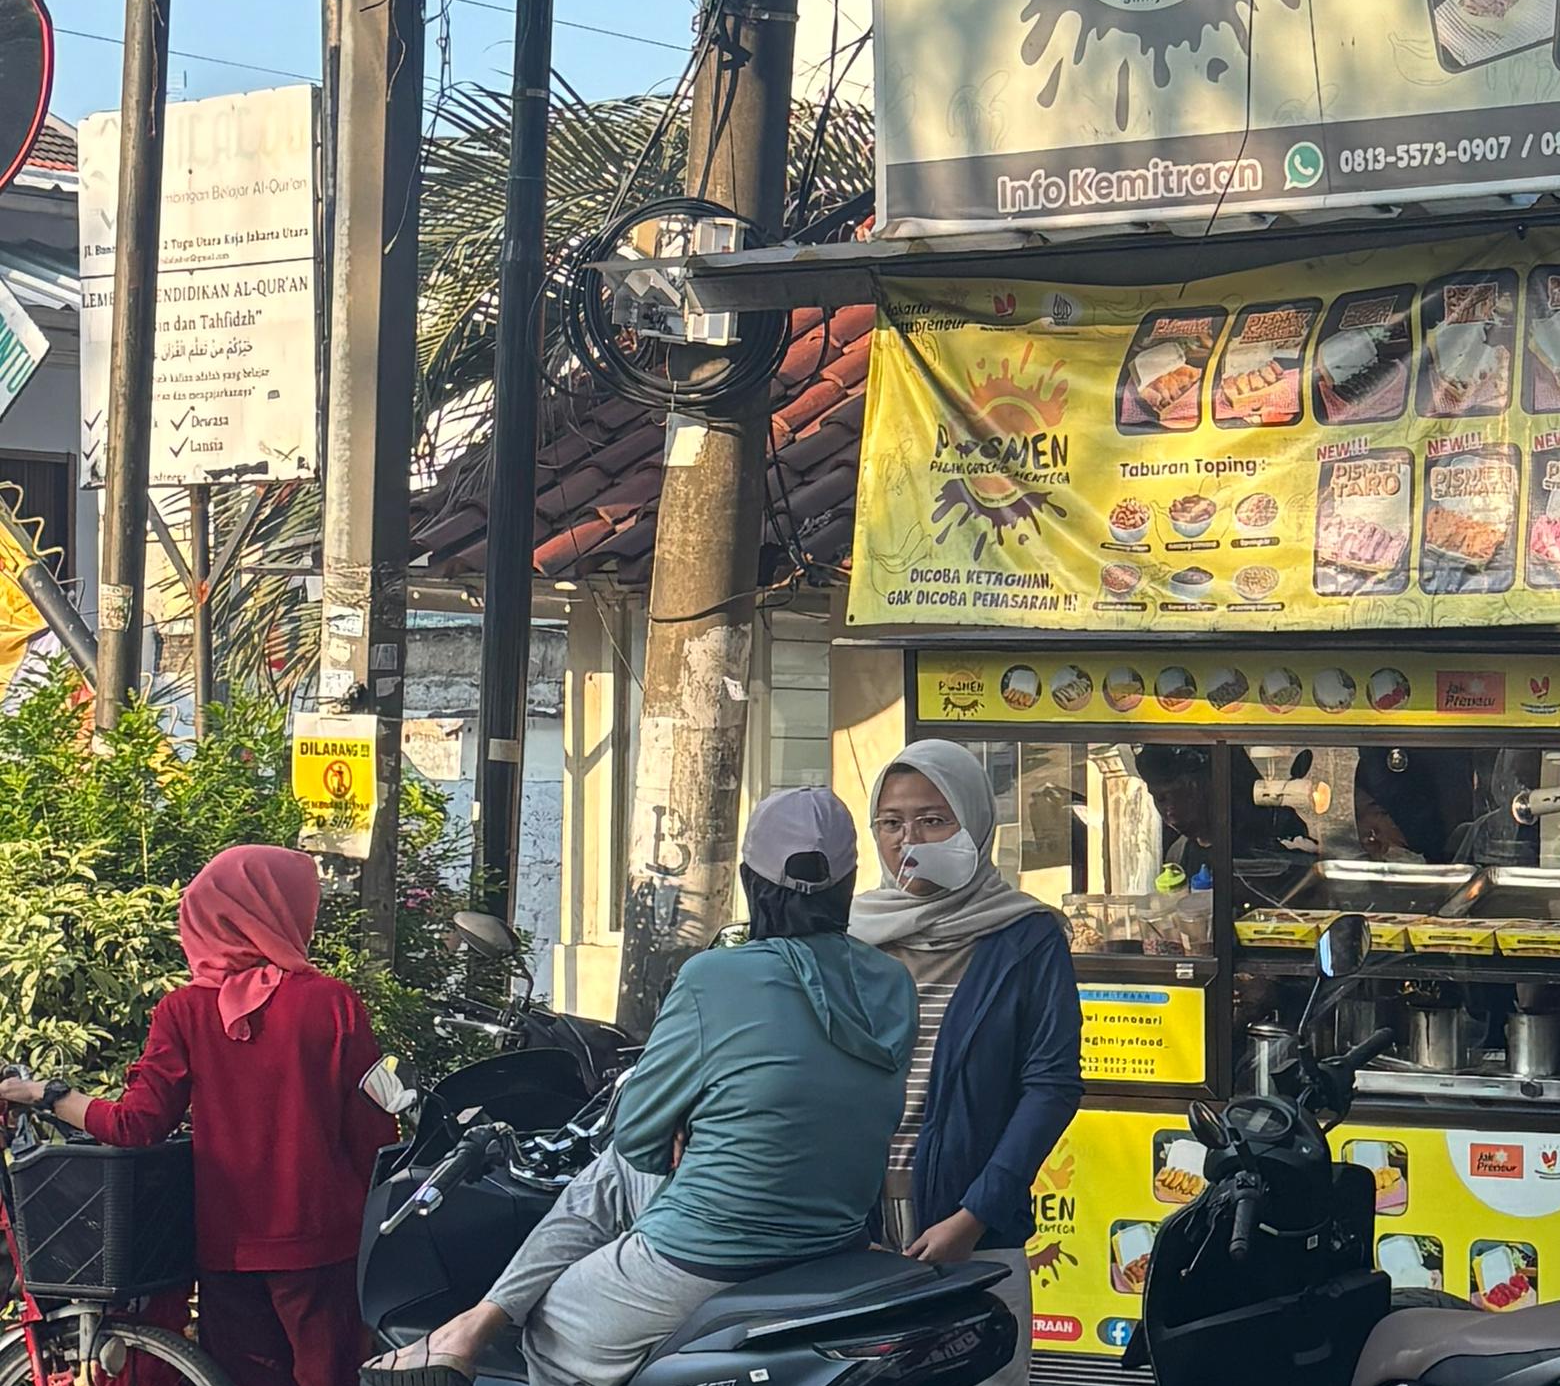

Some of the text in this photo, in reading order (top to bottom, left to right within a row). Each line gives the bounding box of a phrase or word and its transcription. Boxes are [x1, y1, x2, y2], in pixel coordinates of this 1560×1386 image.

[998, 169, 1066, 213] Info
[1069, 158, 1263, 207] Kemitraan
[1339, 135, 1512, 174] 0813-5573-0907
[1519, 132, 1535, 159] /
[196, 235, 222, 248] Utara
[245, 228, 280, 245] Jakarta
[282, 226, 309, 240] Utara
[155, 282, 230, 304] ENDIDIKAN
[233, 275, 309, 298] AL-QUR'AN
[173, 316, 197, 332] dan
[1316, 437, 1369, 461] NEW!!!
[1427, 432, 1482, 456] NEW!!!
[1120, 457, 1258, 479] Taburan Toping
[1332, 472, 1401, 497] TARO
[909, 567, 961, 585] DICOBA
[887, 589, 912, 606] GAK
[915, 589, 967, 607] DICOBA
[299, 741, 359, 758] DILARANG
[1038, 1222, 1076, 1235] ENTEGA
